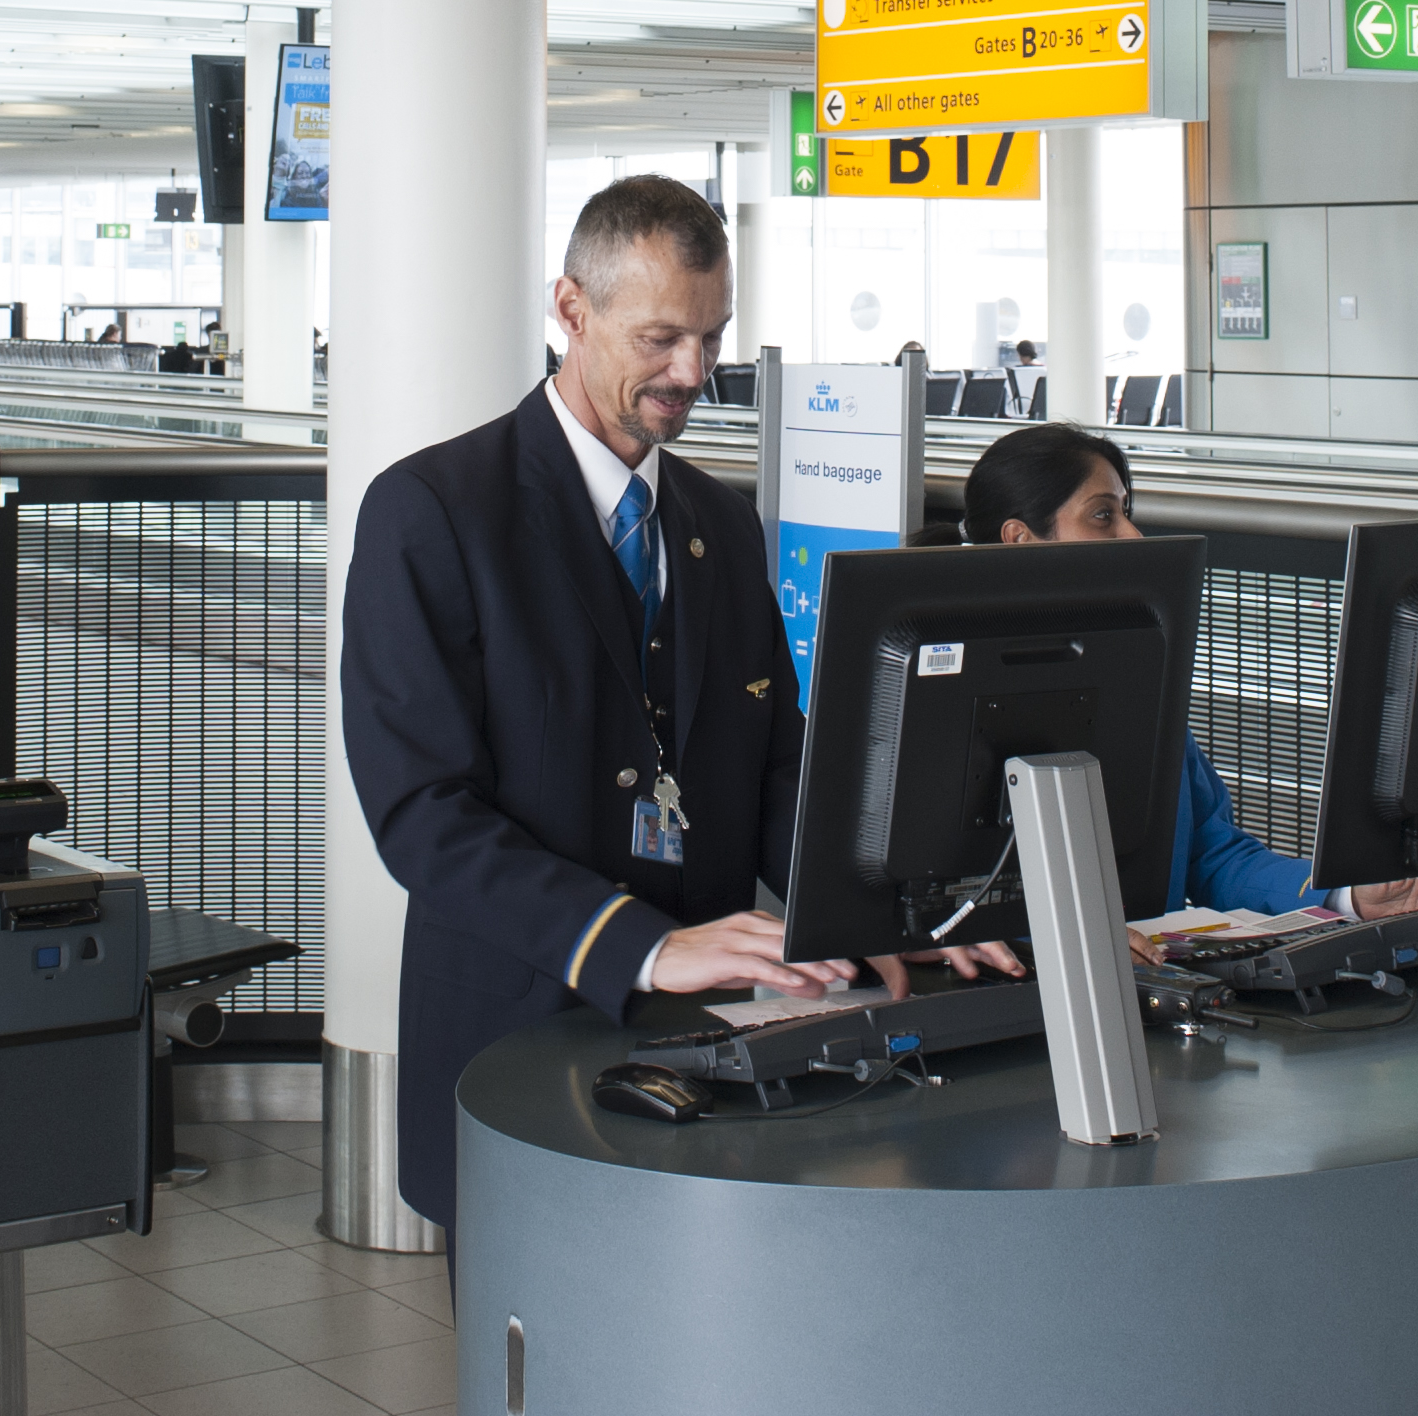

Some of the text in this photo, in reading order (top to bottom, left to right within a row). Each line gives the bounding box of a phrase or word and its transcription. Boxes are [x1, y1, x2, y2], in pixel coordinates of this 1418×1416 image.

[974, 27, 1084, 58] Gates B 20-36
[874, 89, 980, 113] All other gates
[299, 107, 330, 122] FRE
[834, 164, 864, 178] Gate
[889, 131, 1014, 187] B17
[808, 397, 839, 412] KLM
[794, 459, 882, 484] Hand baggage
